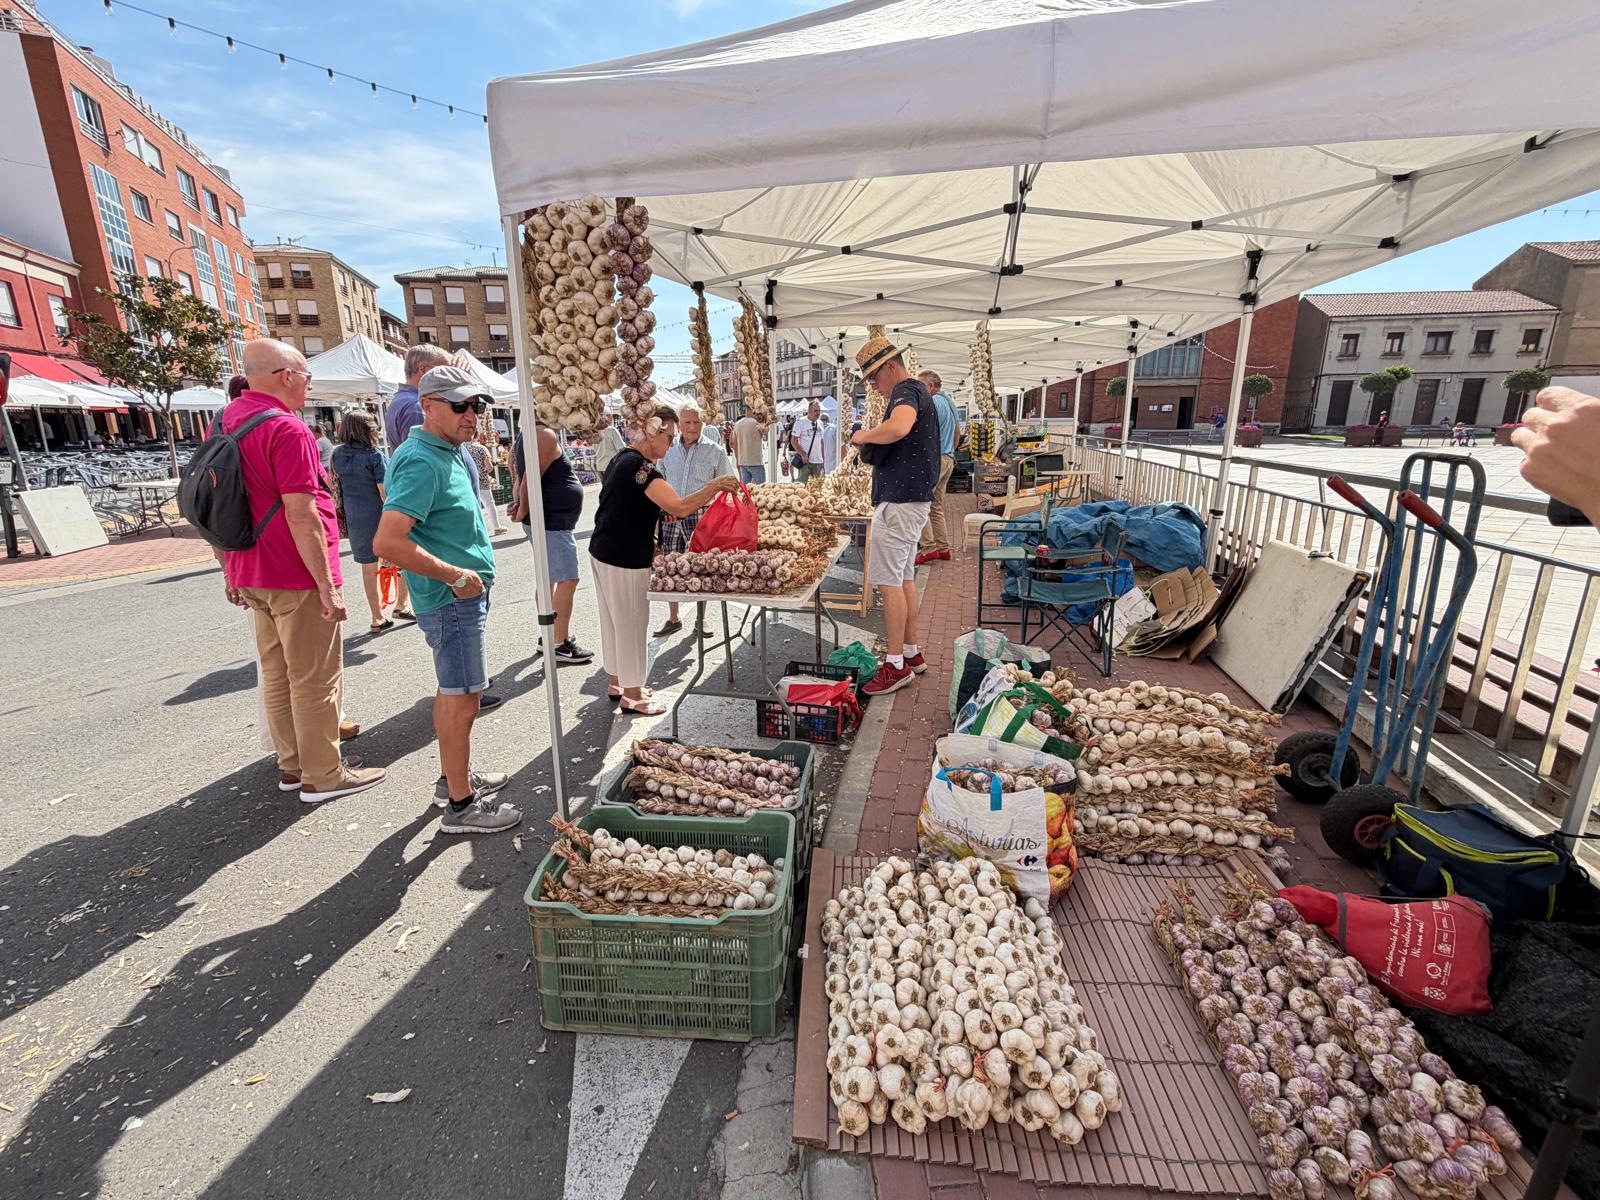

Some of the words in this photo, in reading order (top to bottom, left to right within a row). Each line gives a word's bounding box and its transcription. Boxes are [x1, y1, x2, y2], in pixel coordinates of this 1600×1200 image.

[947, 817, 1041, 850] Asturias
[1400, 921, 1412, 948] violencia
[1397, 956, 1406, 977] contra
